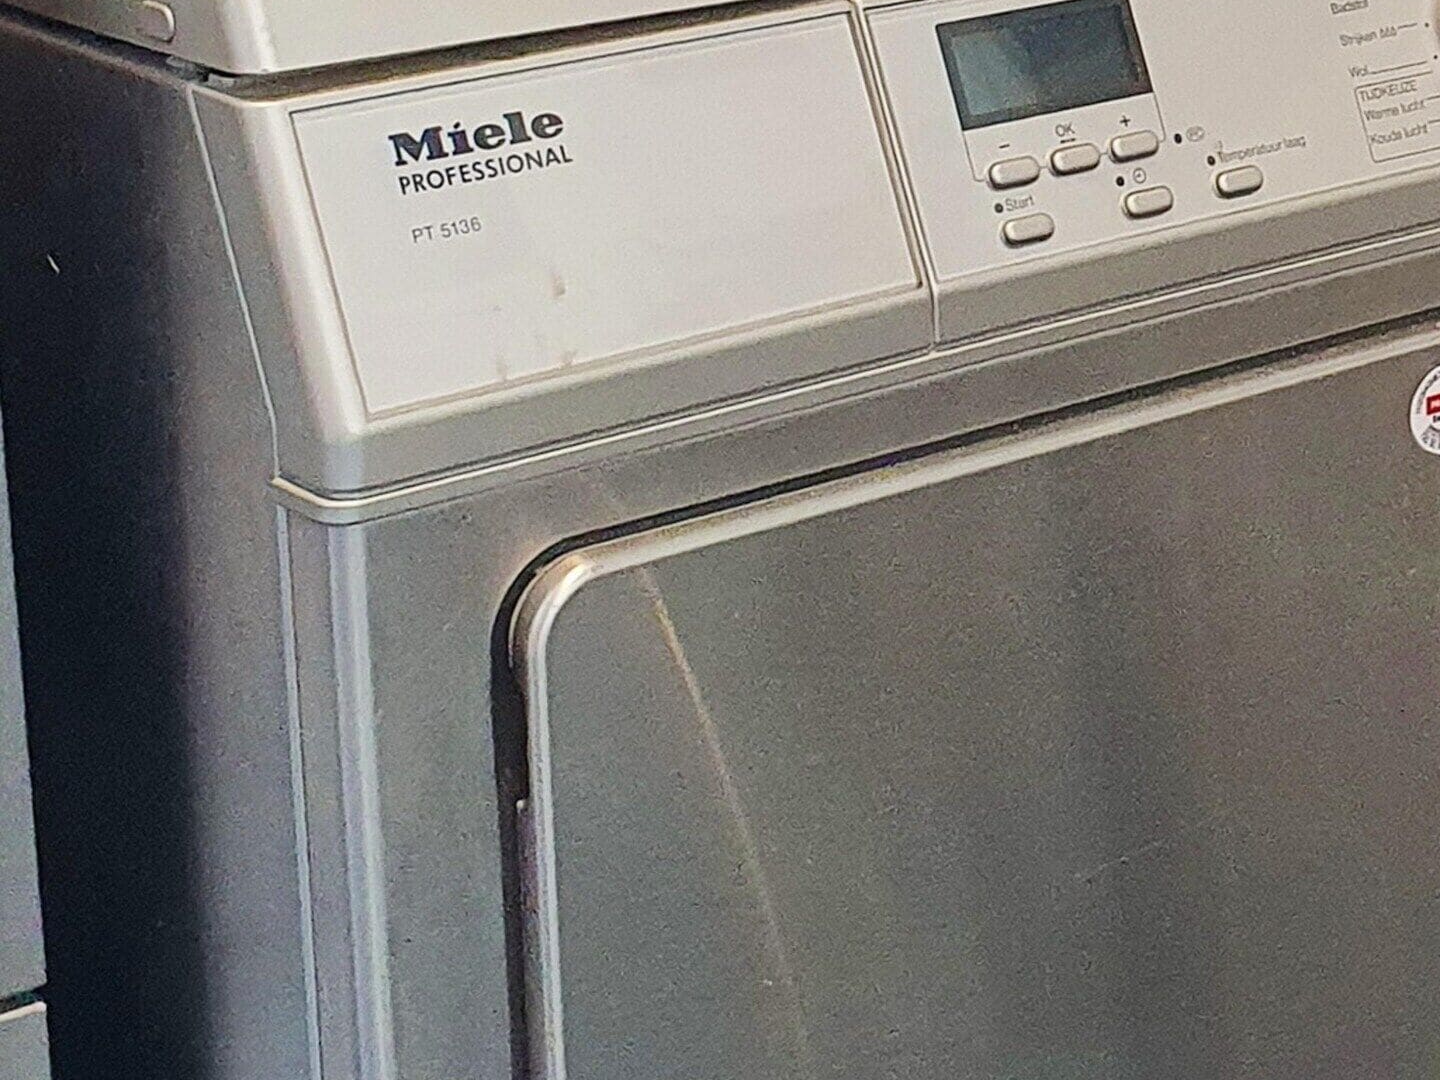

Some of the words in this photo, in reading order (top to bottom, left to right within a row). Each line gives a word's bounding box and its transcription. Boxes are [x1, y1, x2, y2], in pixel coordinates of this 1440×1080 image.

[1363, 107, 1399, 121] Warme
[1400, 100, 1426, 113] lucht
[388, 111, 564, 166] Miele
[1055, 123, 1075, 137] OK
[1368, 130, 1403, 145] Koude
[1402, 124, 1428, 138] lucht
[1217, 141, 1282, 163] Temperatuur
[398, 145, 573, 195] PROFESSIONAL
[1005, 195, 1034, 212] Start
[412, 226, 433, 243] PT
[441, 217, 482, 239] 5136
